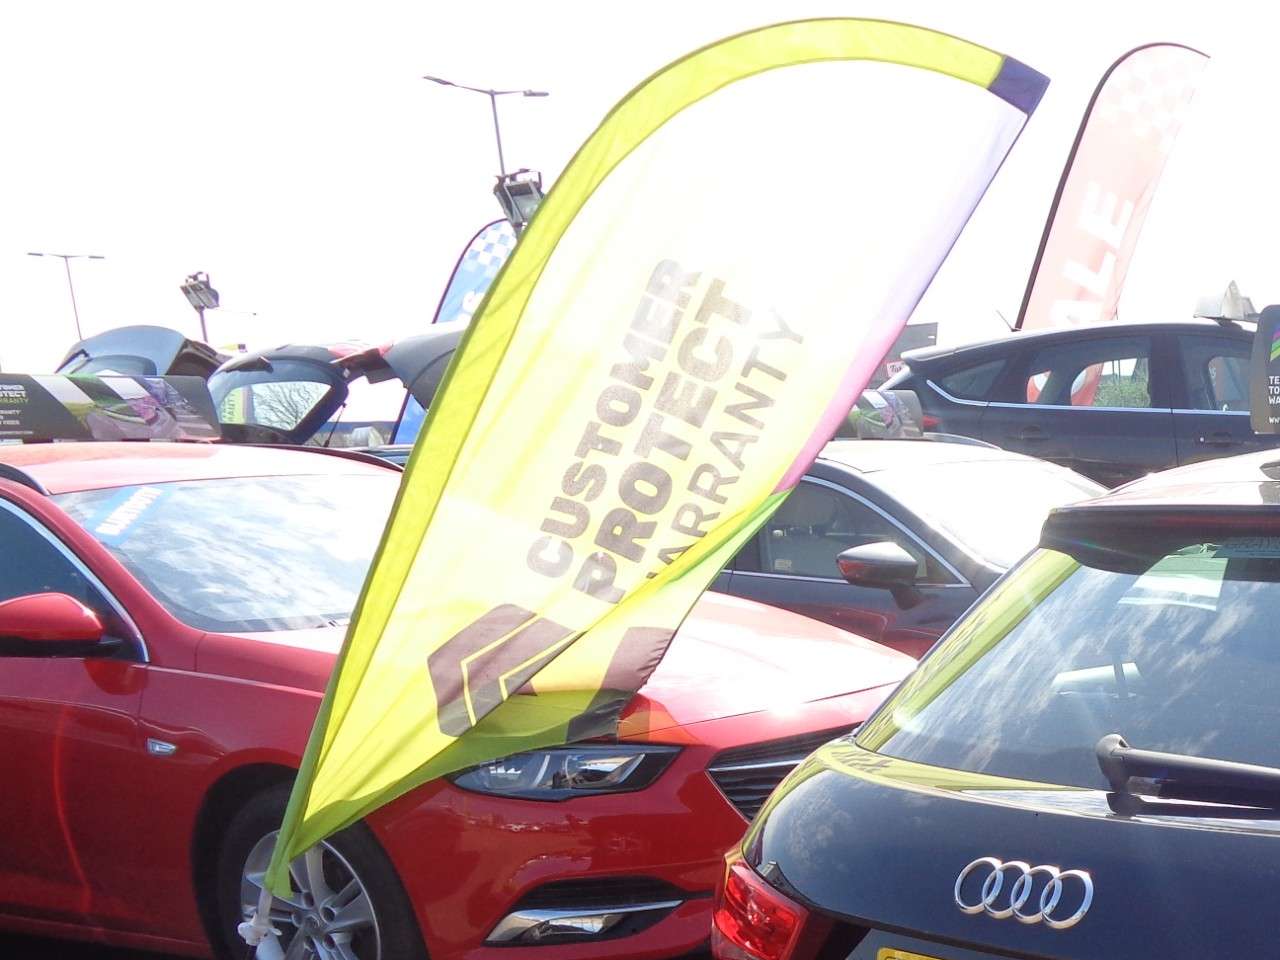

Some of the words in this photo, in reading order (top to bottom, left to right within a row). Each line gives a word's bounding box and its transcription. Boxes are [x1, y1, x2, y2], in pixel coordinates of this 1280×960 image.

[527, 259, 702, 578] CUSTOMER
[572, 278, 752, 604] PROTECT
[1269, 386, 1280, 394] TO
